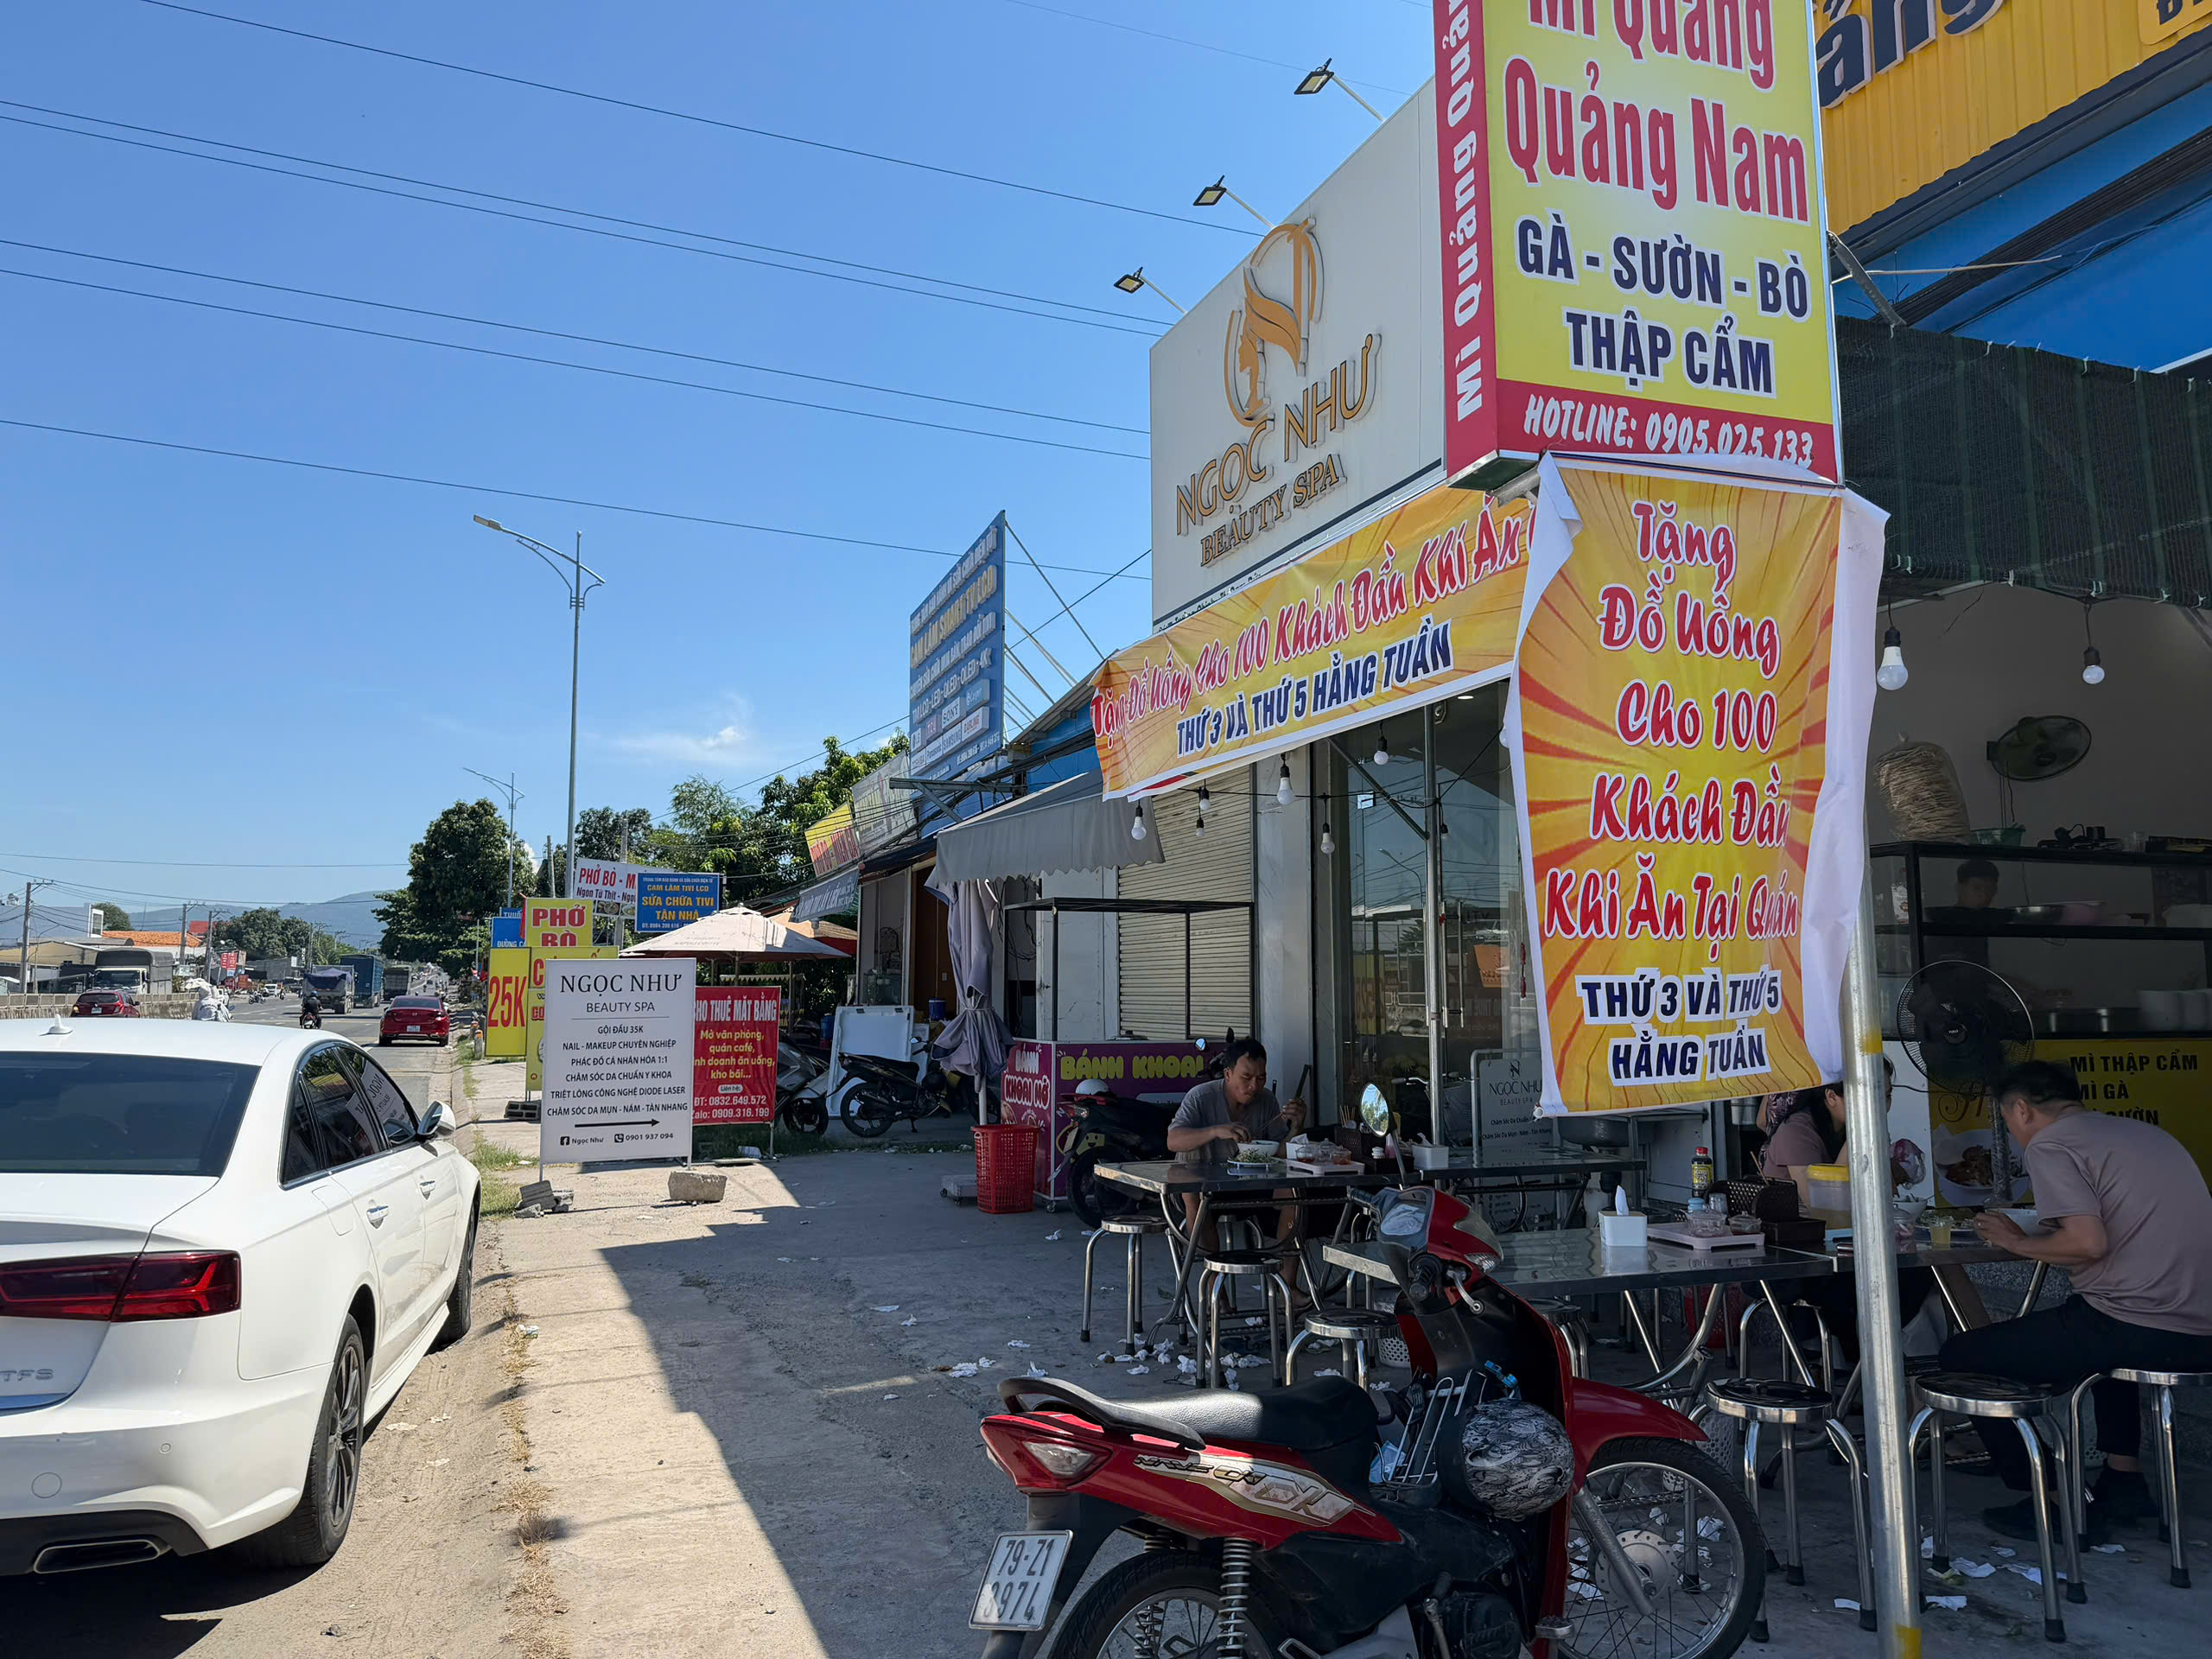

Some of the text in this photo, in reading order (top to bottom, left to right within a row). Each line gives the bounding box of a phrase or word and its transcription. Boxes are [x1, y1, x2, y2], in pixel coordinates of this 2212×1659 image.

[1504, 58, 1808, 222] Quảng Nam
[1449, 130, 1481, 326] Quảng
[1518, 213, 1808, 319] GÀ SƯỜN BÒ
[1567, 310, 1772, 393] THẬP CẨM
[1177, 334, 1377, 536] NGỌC NHƯ
[1524, 394, 1814, 470] HOTLINE: 0905.025.133
[1200, 454, 1341, 567] BEAUTY SPA
[1633, 501, 1736, 585] Tặng
[1091, 689, 1127, 749] Tặng
[1128, 657, 1147, 723] Đồ
[1150, 645, 1192, 715] Uống
[1194, 639, 1230, 696] Cho
[1233, 617, 1270, 680] 100
[1273, 585, 1350, 664] Khách
[1351, 541, 1408, 632] Đầu
[1413, 519, 1468, 608] Khi
[1473, 496, 1522, 584] Ăn
[1598, 569, 1781, 680] Đồ Uống
[1178, 616, 1451, 756] THỨ 3 VÀ THỨ 5 HẰNG TUẦN
[942, 703, 959, 724] SONY
[1617, 680, 1777, 753] Cho 100
[1590, 763, 1791, 848] Khách Đầu
[578, 864, 601, 886] PHỞ
[602, 867, 617, 887] BÒ
[576, 887, 593, 899] Ngon
[604, 890, 616, 901] Thịt
[642, 893, 715, 906] SỬA CHỮA TIVI
[532, 904, 586, 927] PHỞ
[655, 909, 699, 922] TẬN NHÀ
[1543, 868, 1620, 939] Khi
[1626, 852, 1686, 940] Ăn
[1692, 871, 1742, 962] Tại
[1745, 870, 1798, 940] Quán
[541, 930, 577, 947] BÒ
[560, 974, 683, 997] NGỌC NHƯ
[1581, 968, 1778, 1018] THỨ 3 VÀ THỨ 5
[487, 976, 528, 1027] 25K
[586, 1001, 656, 1013] BEAUTY SPA
[695, 991, 778, 1027] HO THUÊ MẶT BẰNG
[585, 1041, 617, 1051] MAKEUP
[618, 1039, 648, 1049] CHUYÊN
[649, 1039, 677, 1050] NGHIỆP
[700, 1028, 765, 1041] Mở văn phòng,
[571, 1056, 591, 1066] PHÁC
[605, 1055, 616, 1065] CÁ
[617, 1055, 639, 1065] NHÂN
[640, 1054, 656, 1064] HÓA
[708, 1054, 775, 1067] doanh ăn uống,
[709, 1042, 755, 1055] quán café,
[1015, 1043, 1039, 1075] BÁNH
[1611, 1025, 1766, 1079] HẰNG TUẦN
[710, 1069, 728, 1079] kho
[1060, 1047, 1205, 1080] BÁNH KHOAI
[2069, 1048, 2199, 1075] MÌ THẬP CẨM
[566, 1072, 588, 1082] CHĂM
[590, 1071, 605, 1082] SÓC
[606, 1072, 617, 1081] DA
[1489, 1080, 1520, 1096] NGỌC
[550, 1086, 685, 1101] TRIỆT LÔNG CÔNG NGHỆ DIODE LASER
[694, 1095, 767, 1107] ĐT: 0832.649.572
[1004, 1075, 1033, 1107] KHOAI
[2103, 1080, 2130, 1100] GÀ
[547, 1103, 689, 1116] CHĂM SÓC DA MỤN NÁM TÀN NHANG
[711, 1107, 770, 1119] 0909.316.199
[571, 1137, 589, 1146] Ngọc
[997, 1539, 1056, 1577] 79-Z1
